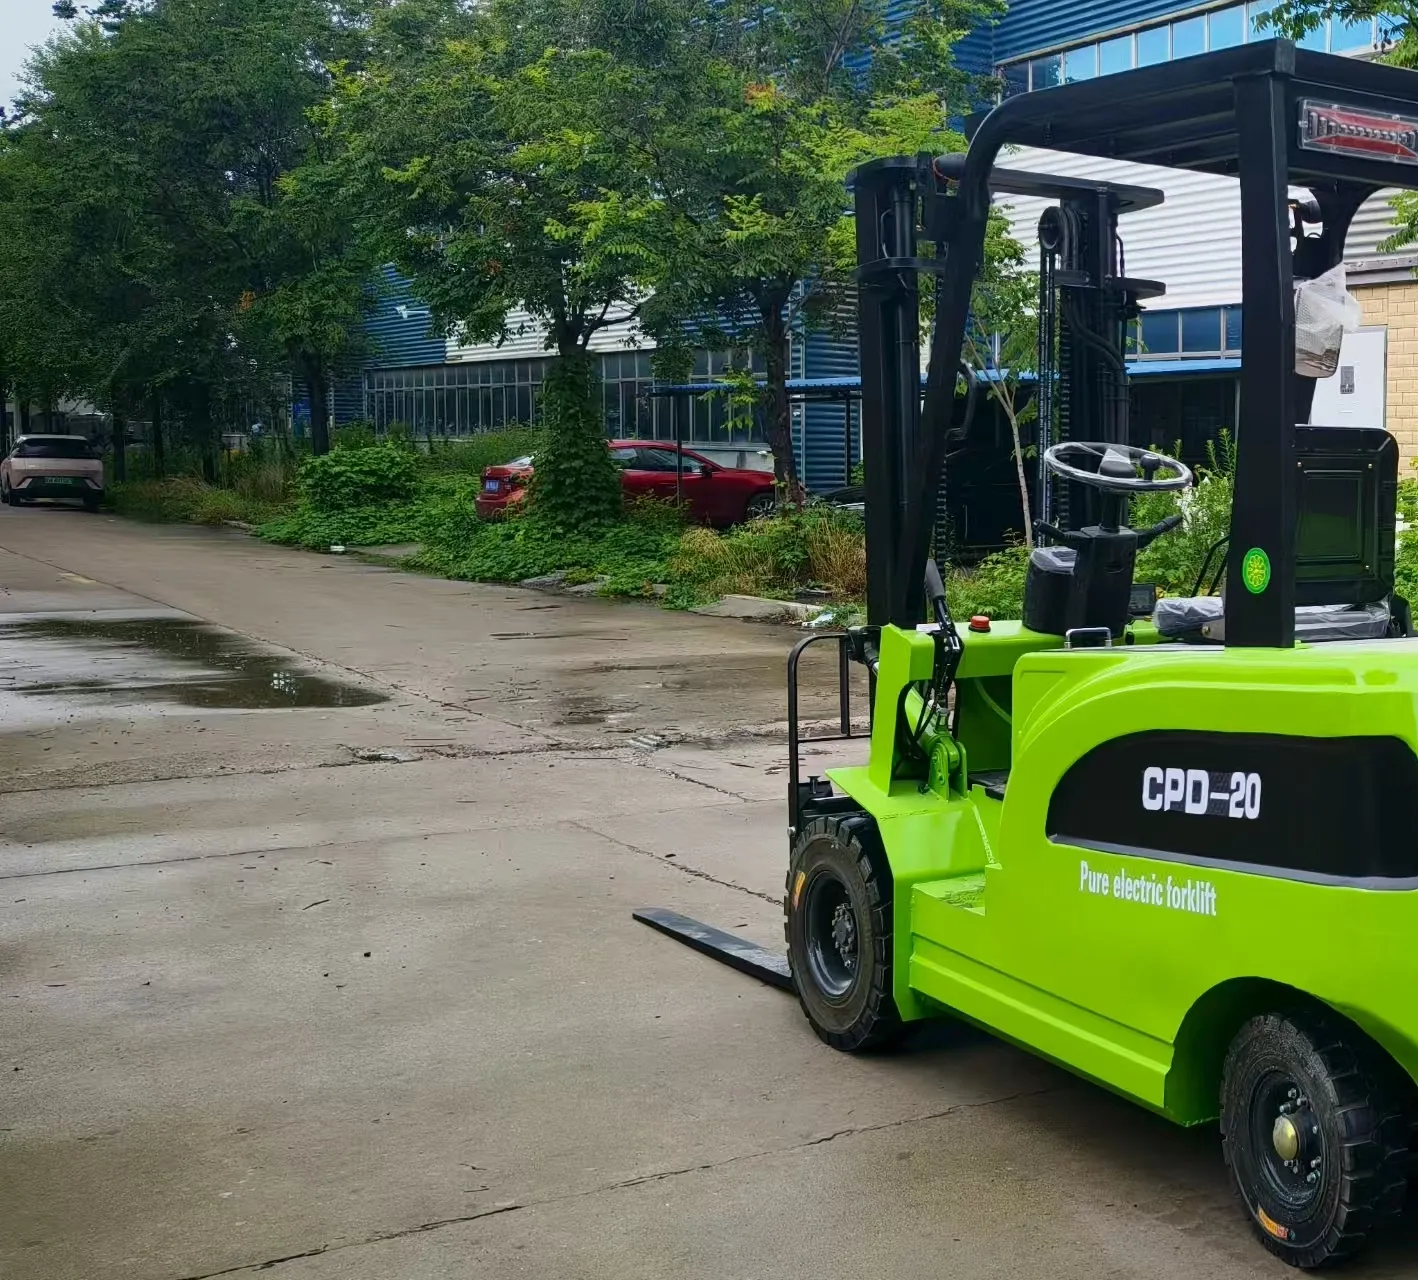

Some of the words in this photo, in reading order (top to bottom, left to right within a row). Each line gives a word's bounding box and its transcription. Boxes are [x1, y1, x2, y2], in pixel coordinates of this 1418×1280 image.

[1141, 766, 1262, 820] CPD-20
[1079, 860, 1110, 896] Pure
[1113, 867, 1164, 906] electric
[1165, 875, 1218, 917] forklift
